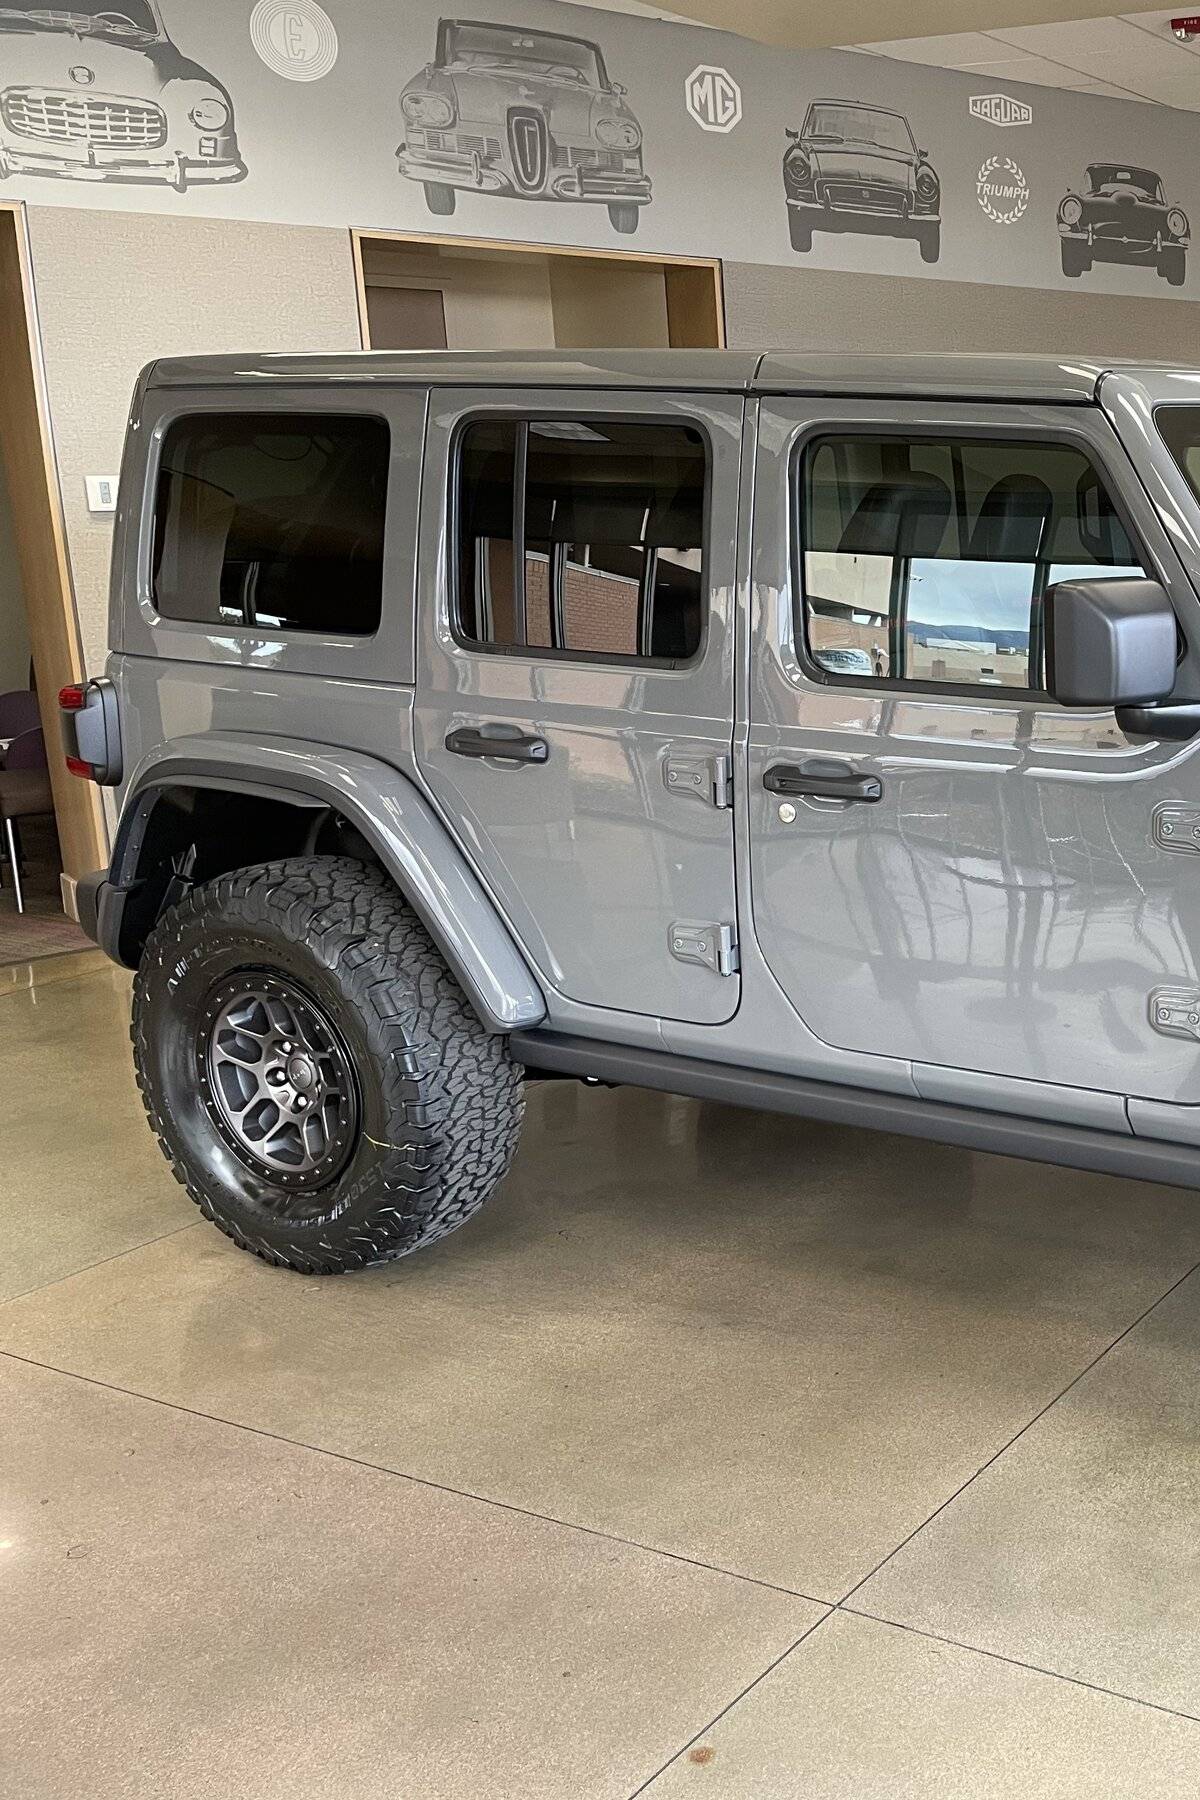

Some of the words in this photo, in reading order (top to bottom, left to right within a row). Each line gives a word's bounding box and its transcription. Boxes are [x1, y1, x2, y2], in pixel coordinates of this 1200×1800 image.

[693, 75, 735, 124] MG
[973, 98, 1029, 122] JAGUAR
[976, 182, 1030, 200] TRIUMPH
